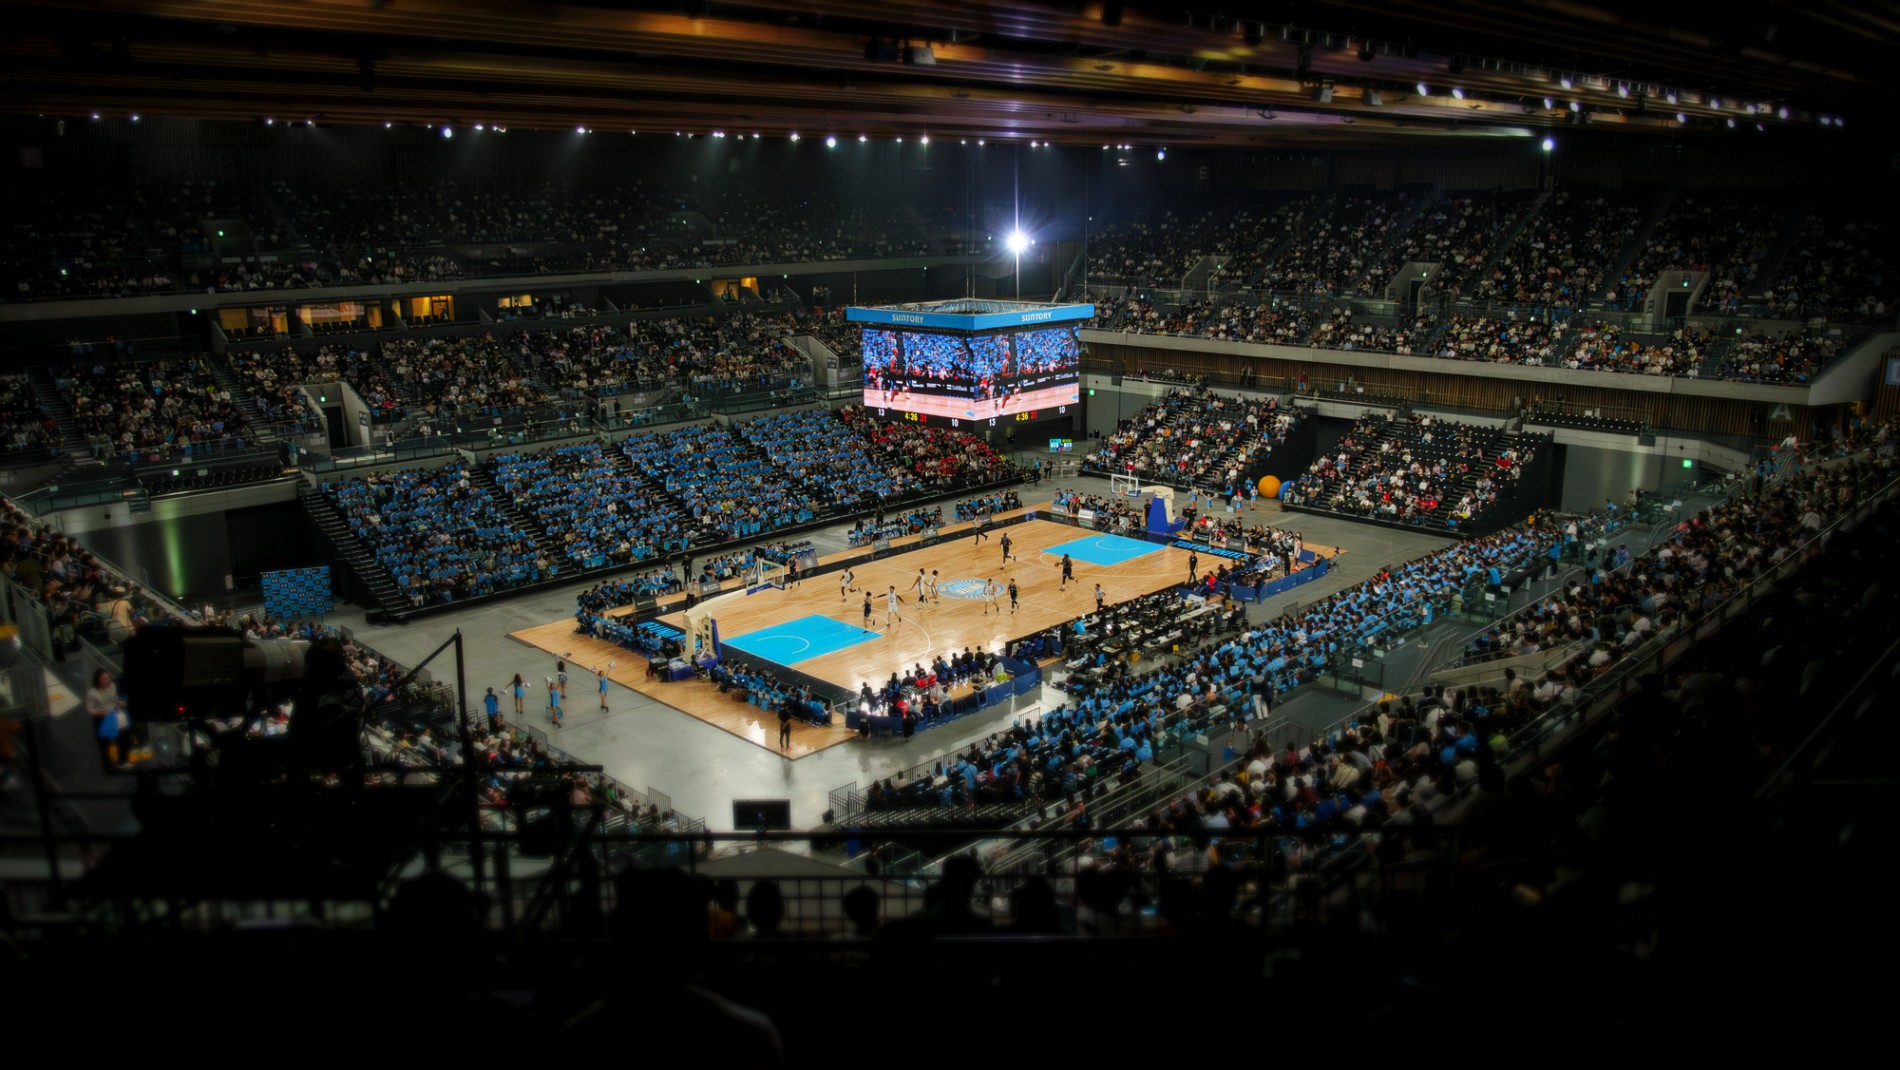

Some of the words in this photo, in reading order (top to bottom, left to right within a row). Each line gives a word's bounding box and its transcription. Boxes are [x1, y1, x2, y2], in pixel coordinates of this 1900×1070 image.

[892, 314, 924, 323] SUNTORY
[1021, 312, 1052, 322] SUNTORY
[878, 408, 885, 416] 13
[1058, 406, 1066, 414] 10
[1771, 403, 1792, 420] A
[951, 418, 959, 427] 10
[989, 418, 996, 427] 13
